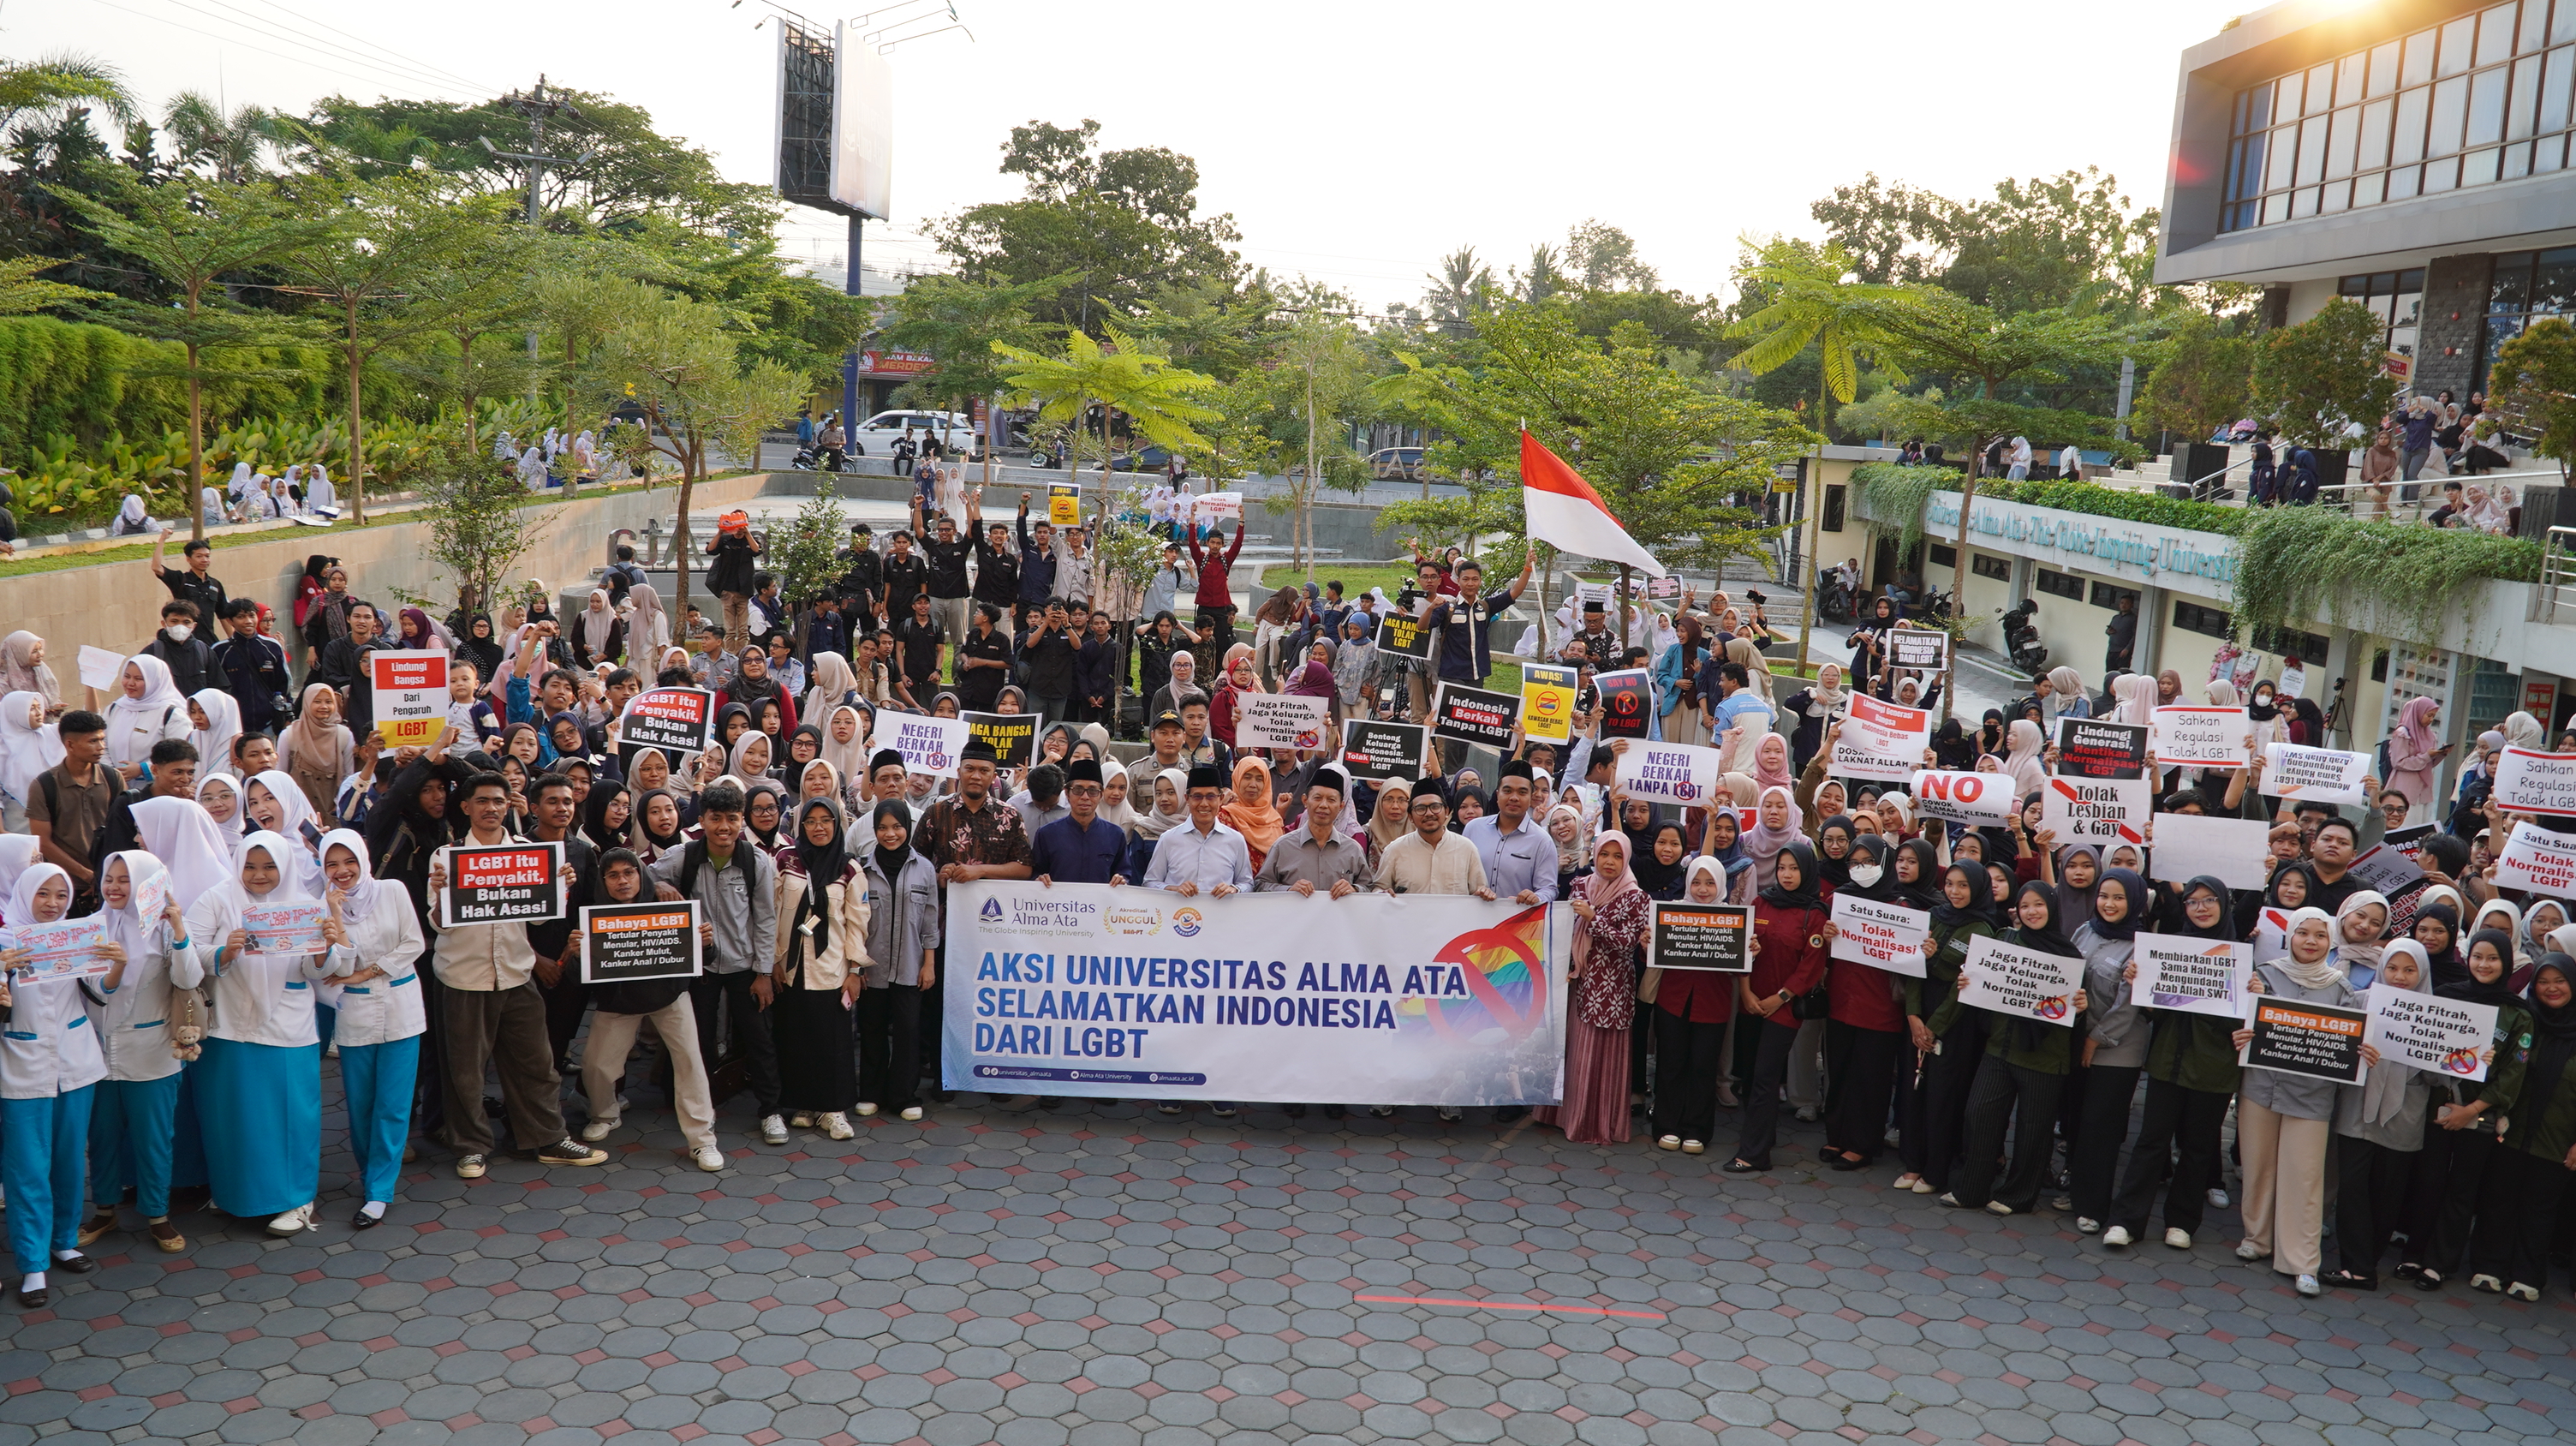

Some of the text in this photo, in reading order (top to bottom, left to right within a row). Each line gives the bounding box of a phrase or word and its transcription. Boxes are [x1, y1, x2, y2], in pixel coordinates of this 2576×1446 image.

[1973, 506, 1999, 535] Alma
[2030, 517, 2052, 547] The
[2056, 520, 2090, 553] Globe
[2093, 527, 2153, 575] Inspiring
[2159, 537, 2239, 582] Universit
[1384, 618, 1400, 628] JAGA
[1393, 629, 1416, 640] TOLAK
[1893, 635, 1941, 646] SELAMATKAN
[1394, 637, 1411, 648] LGBT
[1899, 645, 1935, 654] INDONESIA
[1899, 654, 1934, 664] DARI LGBT
[391, 661, 427, 672] Lindungi
[395, 676, 425, 685] Bangsa
[1535, 670, 1563, 682] AWAS!
[1607, 677, 1637, 687] SAY NO
[404, 693, 420, 702] Dari
[641, 694, 697, 708] LGBT itu
[393, 706, 431, 715] Pengaruh
[1255, 701, 1277, 709] Jaga
[1449, 696, 1510, 715] Indonesia
[635, 705, 699, 723] Penyakit,
[1248, 708, 1317, 720] Jaga Keluarga,
[1455, 708, 1499, 725] Berkah
[2179, 714, 2220, 726] Sahkan
[397, 721, 427, 736] LGBT
[646, 717, 688, 732] Bukan
[902, 723, 942, 738] NEGERI
[993, 725, 1031, 736] BANGSA
[1254, 725, 1310, 735] Normalisasi
[1440, 716, 1510, 738] Tanpa LGBT
[1862, 723, 1887, 737] Indonesia
[631, 727, 697, 747] Hak Asasi
[1368, 732, 1400, 742] Benteng
[2078, 725, 2132, 741] Lindungi
[2174, 731, 2223, 746] Regulasi
[897, 737, 943, 751] BERKAH
[1366, 740, 1401, 749] Keluarga
[2073, 735, 2133, 750] Generasi,
[1347, 752, 1416, 765] Tolak Normalisasi
[1363, 747, 1404, 756] Indonesia:
[2074, 745, 2131, 758] Hentikan
[2167, 746, 2233, 758] Tolak LGBT
[1647, 751, 1690, 767] NEGERI
[1839, 756, 1908, 767] LAKNAT ALLAH
[2064, 753, 2139, 769] Normalisasi
[1643, 766, 1690, 781] BERKAH
[2084, 765, 2116, 776] LGBT
[2526, 761, 2573, 774] Sahkan
[1628, 779, 1668, 795] TANPA
[1922, 774, 1983, 804] NO
[2520, 777, 2576, 794] Regulasi
[2077, 786, 2119, 802] Tolak
[2509, 792, 2545, 805] Tolak
[2067, 803, 2126, 819] Lesbian
[2091, 821, 2120, 838] Gay
[2524, 832, 2549, 845] Satu
[469, 855, 539, 870] LGBT itu
[2534, 852, 2574, 868] Tolak
[463, 870, 544, 887] Penyakit,
[2531, 875, 2570, 888] LGBT
[477, 887, 531, 901] Bukan
[462, 900, 546, 918] Hak Asasi
[1013, 898, 1095, 913] Universitas
[247, 907, 321, 923] STOP DAN TOLAK
[1011, 913, 1077, 927] Alma Ata
[1111, 916, 1155, 924] UNGGUL
[1664, 913, 1739, 925] Bahaya LGBT
[1850, 904, 1910, 923] Satu Suara:
[598, 915, 685, 929] Bahaya LGBT
[641, 929, 678, 937] Penyakit
[1056, 929, 1094, 938] University
[1667, 933, 1698, 941] Menular,
[1861, 923, 1895, 939] Tolak
[1842, 929, 1917, 955] Normalisasi
[1863, 946, 1893, 961] LGBT
[2150, 950, 2237, 968] Membiarkan LGBT
[1990, 949, 2061, 973] Jaga Fitrah,
[977, 952, 1466, 995] AKSI UNIVERSITAS ALMA ATA
[1978, 958, 2069, 986] Jaga Keluarga,
[2162, 962, 2224, 977] Sama Halnya
[2006, 976, 2037, 989] Tolak
[2161, 972, 2224, 989] Mengundang
[1983, 981, 2057, 1003] Normalisasi
[2155, 983, 2228, 1000] Azab Allah SWT
[976, 987, 1396, 1029] SELAMATKAN INDONESIA
[2002, 997, 2033, 1009] LGBT
[975, 1023, 1148, 1058] DARI LGBT
